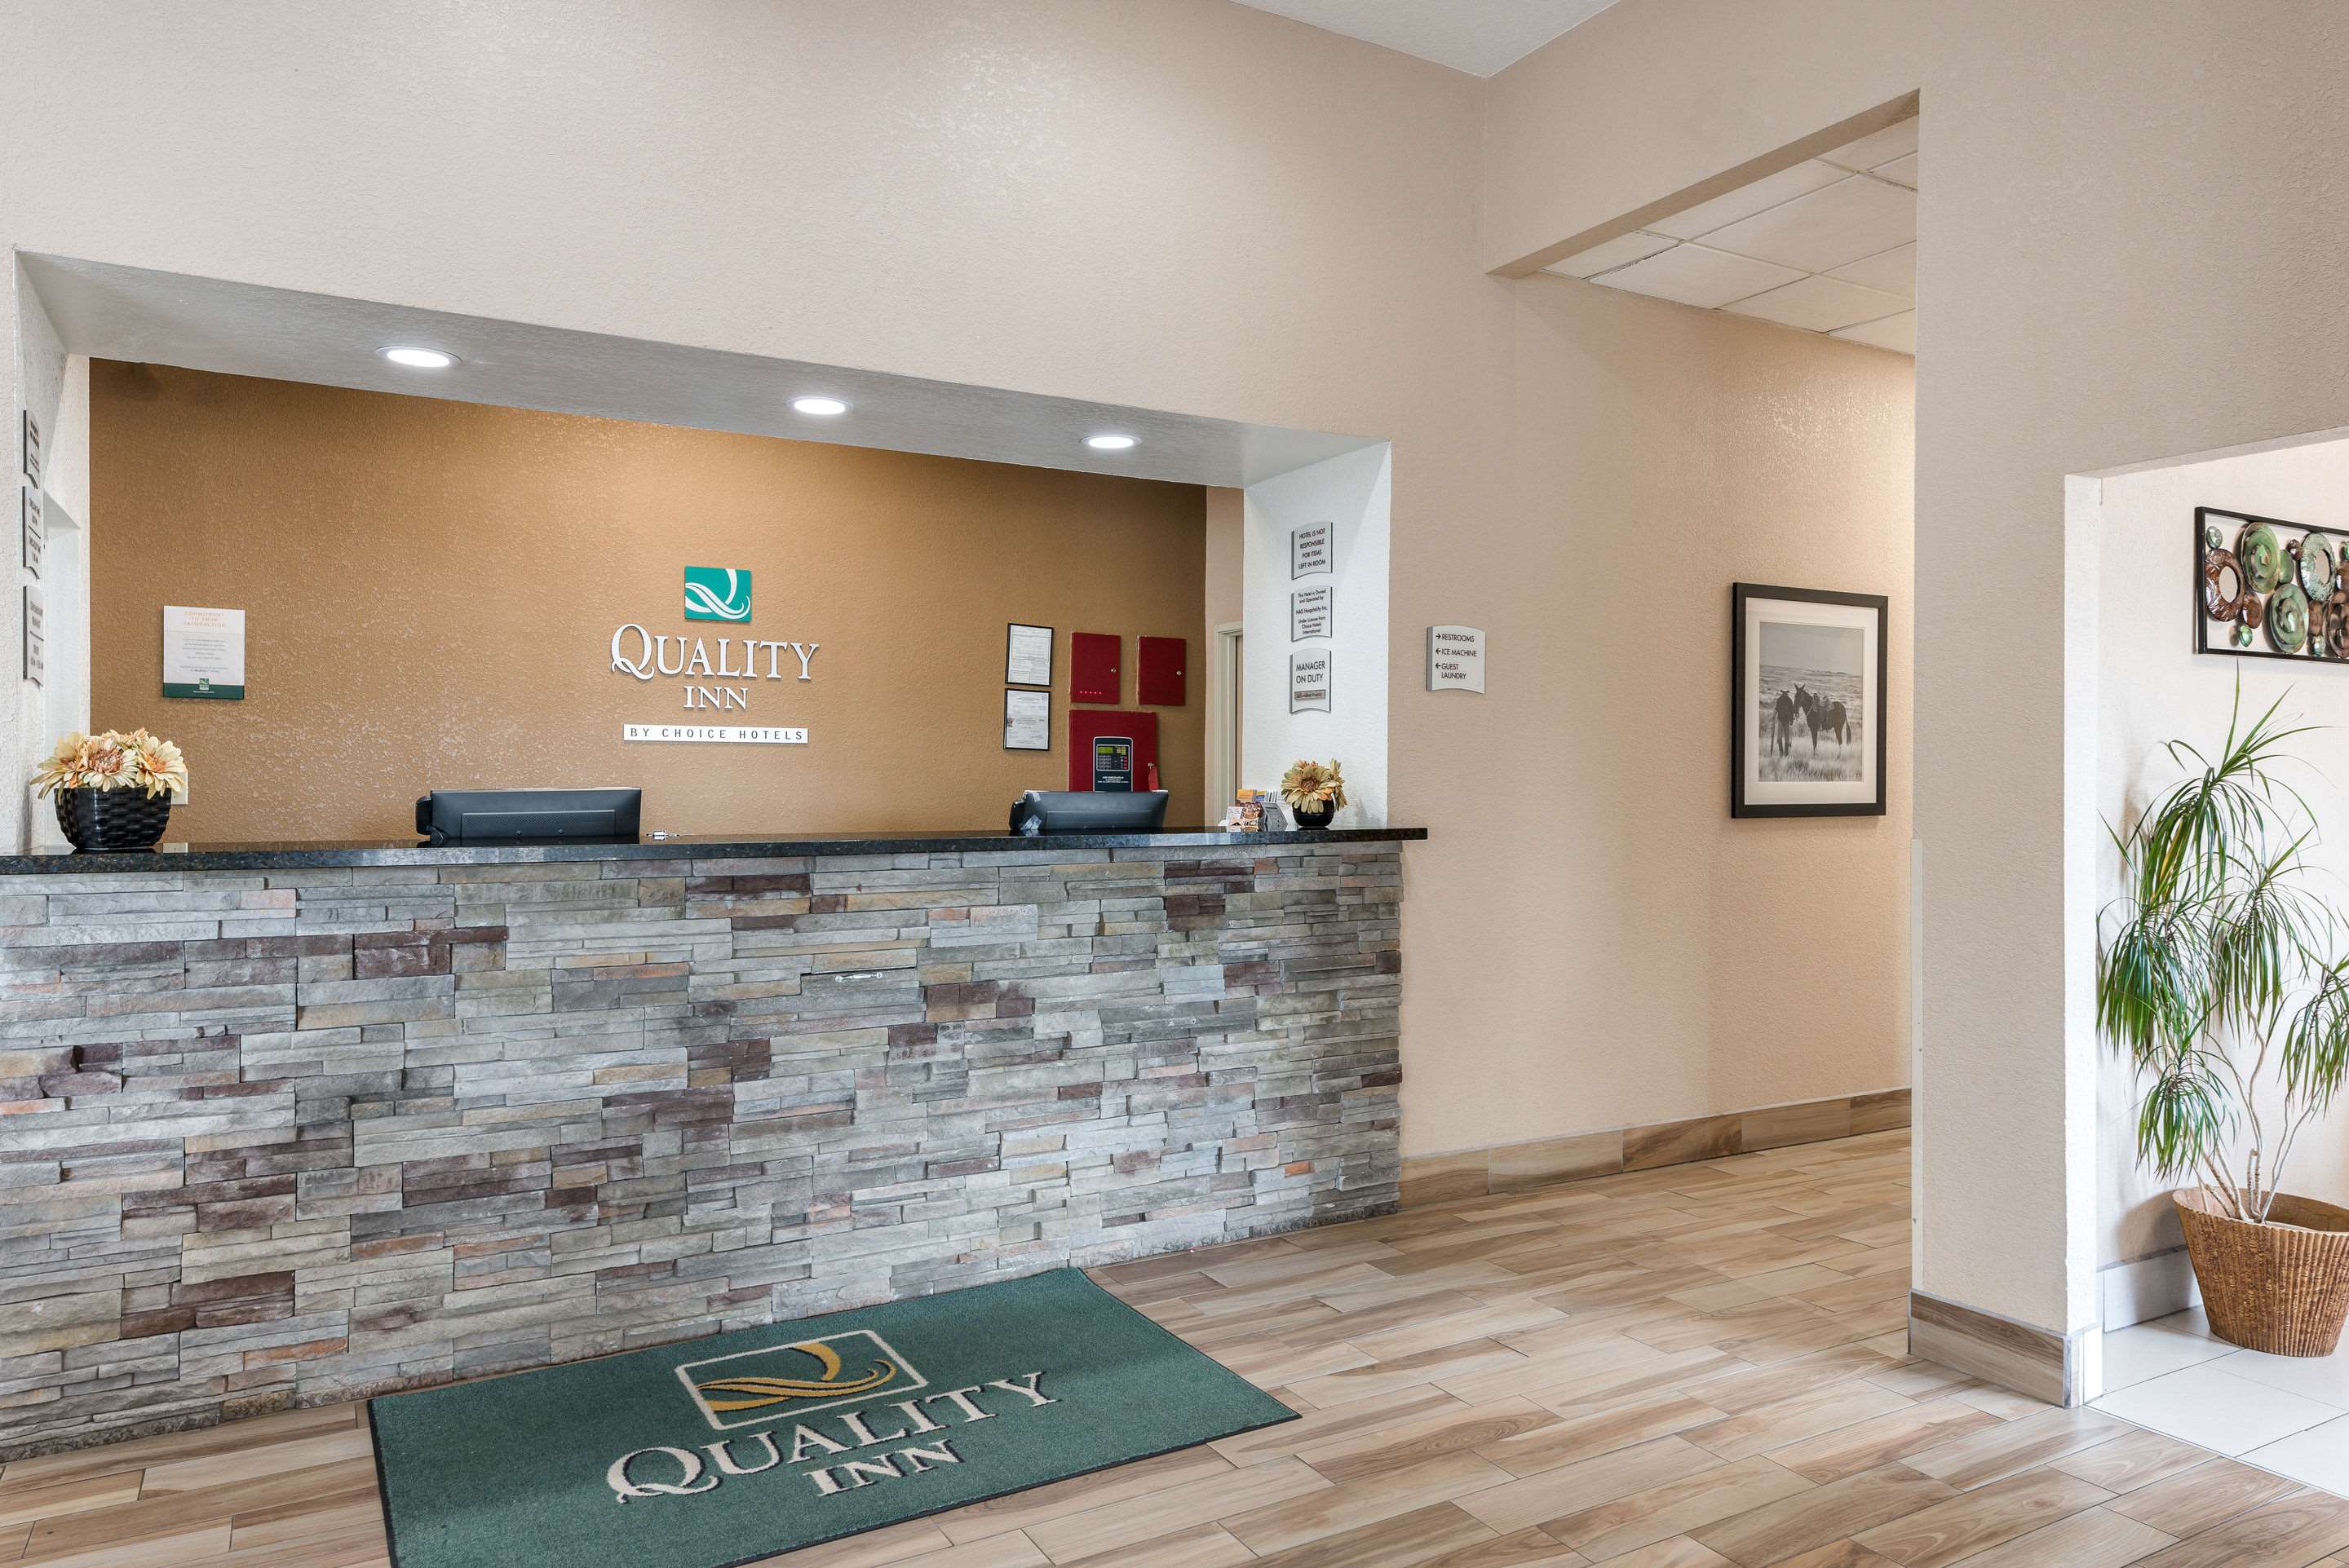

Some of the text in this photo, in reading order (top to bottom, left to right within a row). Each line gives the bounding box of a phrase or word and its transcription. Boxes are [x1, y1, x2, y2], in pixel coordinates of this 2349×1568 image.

[1300, 538, 1325, 549] RESPONSIBLE
[1441, 634, 1475, 643] RESTROOMS
[612, 624, 820, 680] QUALITY
[1296, 660, 1325, 672] MANAGER
[1296, 673, 1324, 684] ON DUTY
[683, 686, 748, 709] INN
[630, 727, 803, 740] BY CHOICE HOTELS
[606, 1370, 1061, 1504] QUALITY
[803, 1438, 966, 1499] INN
